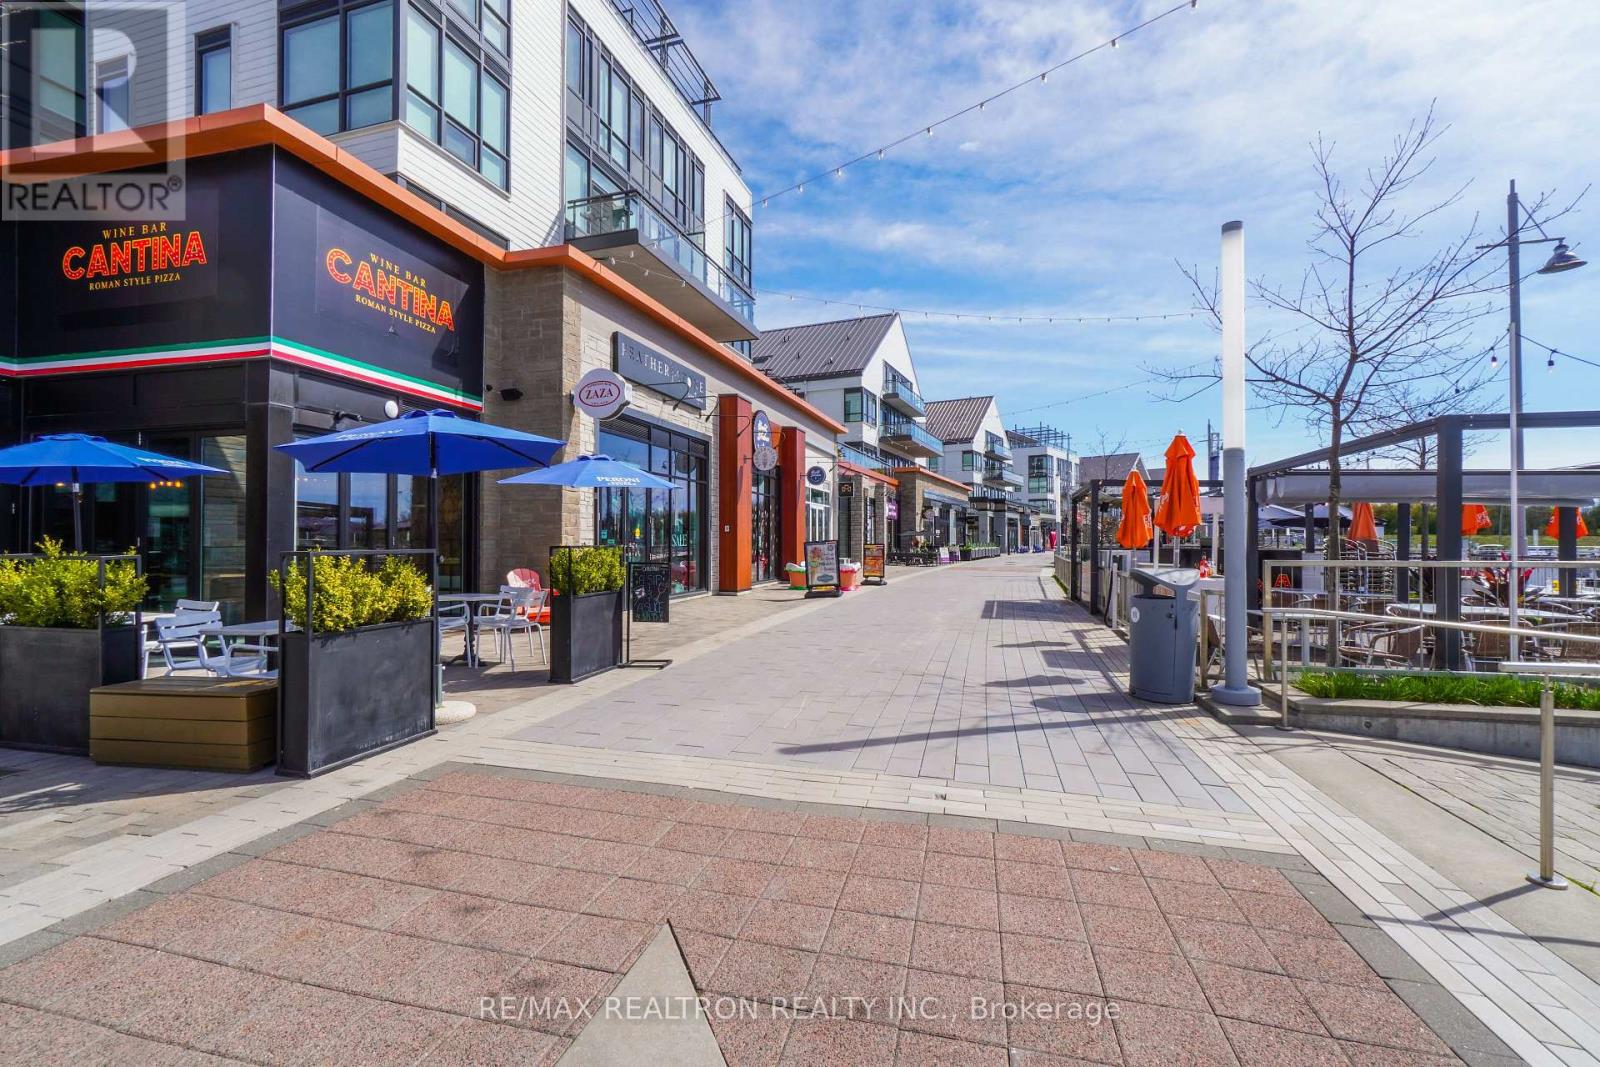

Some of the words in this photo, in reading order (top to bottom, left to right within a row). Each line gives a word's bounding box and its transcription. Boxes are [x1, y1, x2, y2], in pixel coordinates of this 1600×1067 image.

[102, 226, 135, 239] WINE
[142, 222, 167, 234] BAR
[62, 231, 208, 280] CANTINA
[370, 253, 400, 275] WINE
[405, 271, 427, 288] BAR
[89, 280, 121, 291] ROMAN
[123, 277, 151, 287] STYLE
[154, 273, 181, 283] PIZZA
[326, 248, 455, 332] CANTINA
[355, 294, 387, 313] ROMAN
[389, 308, 413, 324] STYLE
[415, 319, 436, 334] PIZZA
[585, 387, 614, 400] ZAZA
